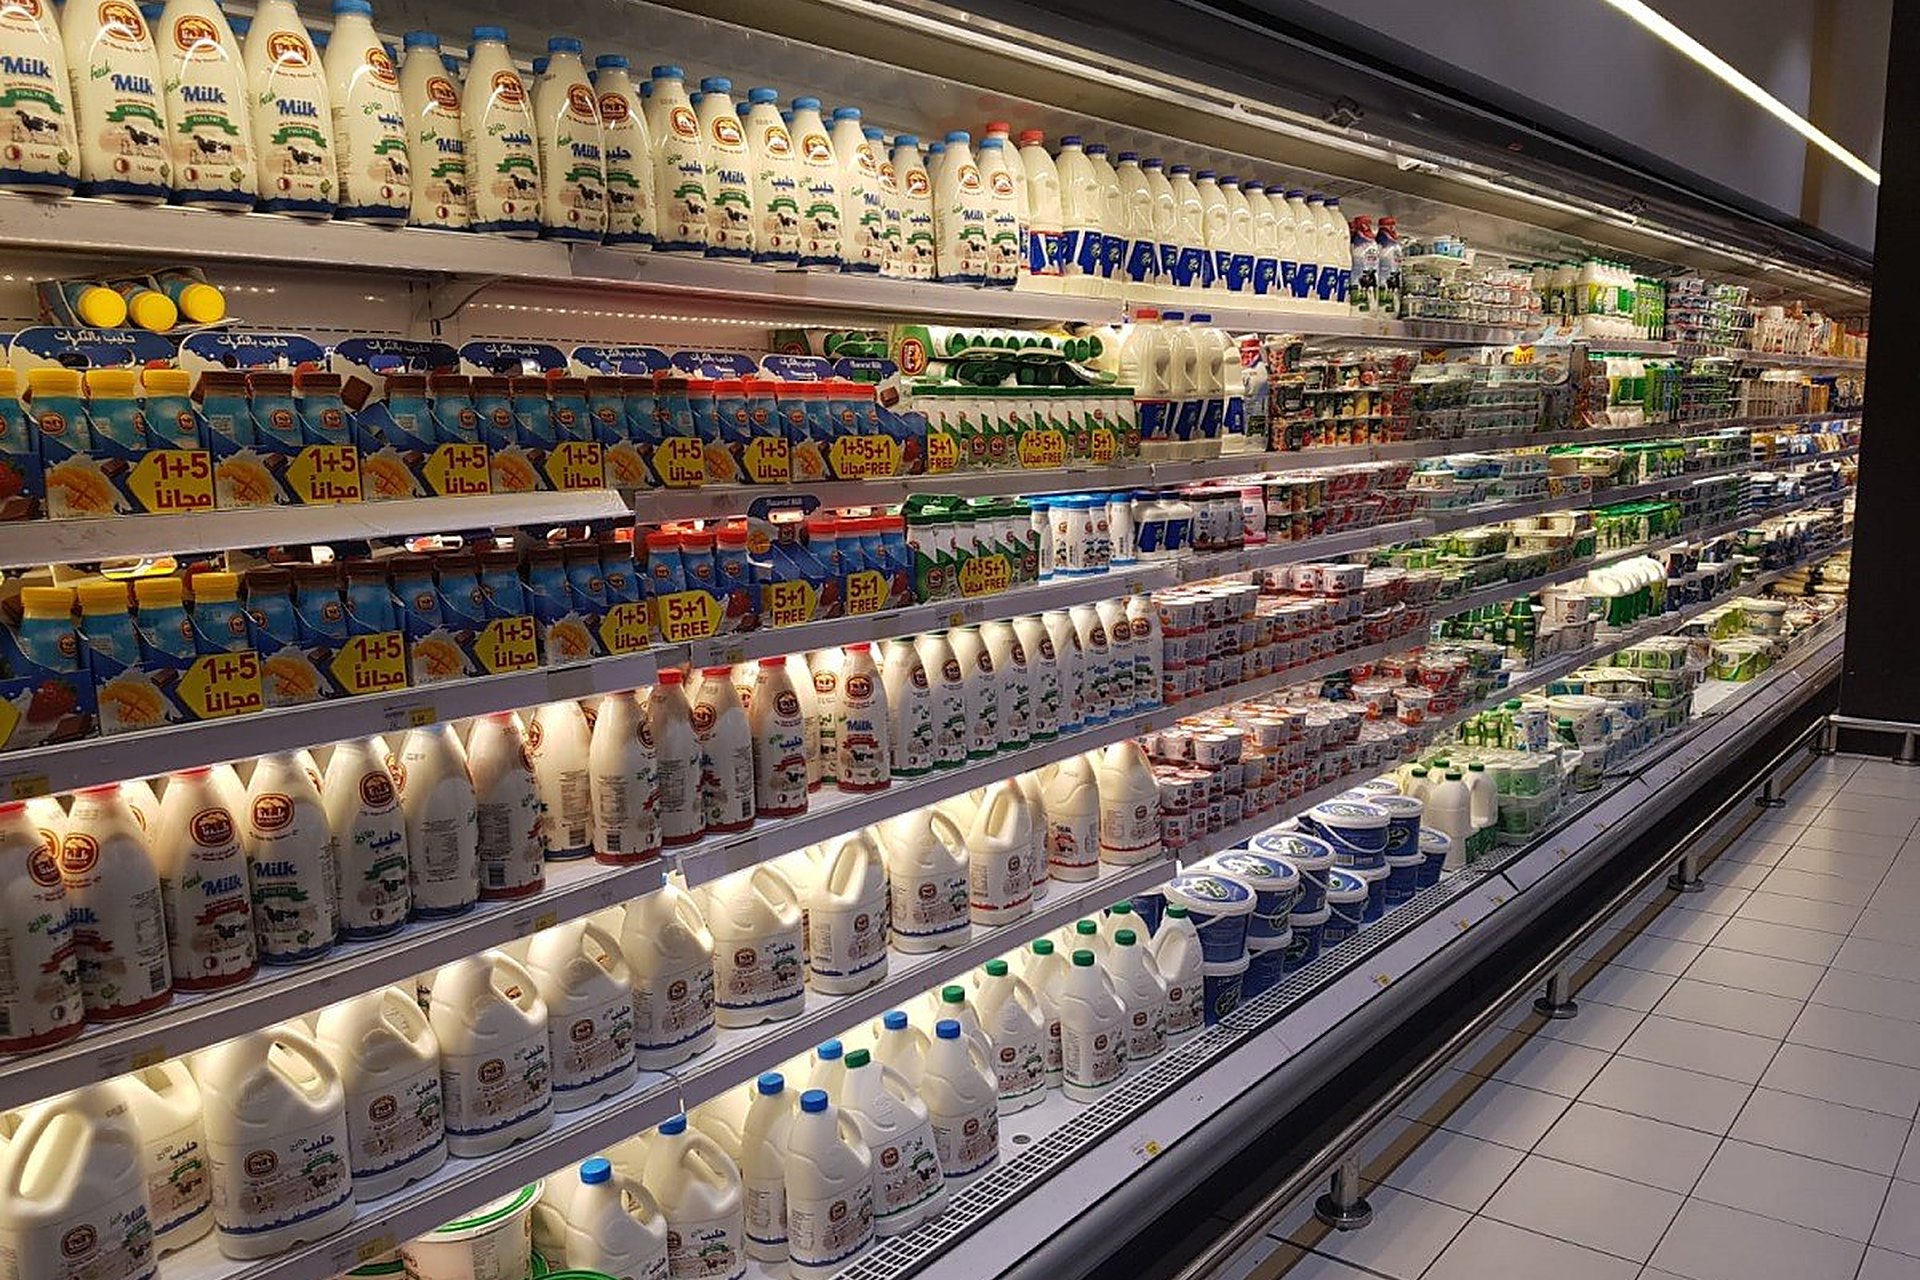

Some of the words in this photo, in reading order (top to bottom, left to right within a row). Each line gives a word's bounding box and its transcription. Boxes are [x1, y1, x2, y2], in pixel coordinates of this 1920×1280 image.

[1, 56, 51, 78] Milk
[111, 74, 155, 95] Milk
[180, 85, 226, 104] Milk
[276, 99, 318, 118] Milk
[501, 130, 532, 148] حليب
[678, 160, 702, 177] حليب
[718, 169, 747, 186] Milk
[771, 176, 795, 191] حليب
[808, 182, 834, 198] حليب
[54, 331, 101, 346] بالنكهات
[103, 333, 136, 344] حليب
[217, 336, 256, 349] بالنكهات
[258, 336, 288, 347] حليب
[668, 439, 701, 459] 1+5
[757, 439, 787, 459] 1+5
[930, 438, 952, 455] 5+1
[1094, 433, 1111, 449] 5+1
[309, 448, 356, 474] 1+5
[444, 446, 485, 469] 1+5
[562, 444, 599, 467] 1+5
[930, 458, 953, 468] FREE
[1093, 450, 1112, 461] FREE
[153, 452, 208, 479] 1+5
[850, 576, 877, 595] 5+1
[775, 587, 805, 606] 5+1
[850, 598, 877, 611] FREE
[615, 606, 646, 626] 1+5
[670, 598, 707, 620] 5+1
[774, 608, 806, 624] FREE
[492, 620, 531, 641] 1+5
[671, 620, 710, 637] FREE
[355, 636, 401, 662] 1+5
[202, 655, 257, 683] 1+5
[847, 720, 873, 731] Milk
[369, 830, 401, 852] حليب
[254, 861, 297, 877] Milk
[201, 875, 243, 896] Milk
[170, 1140, 198, 1161] حليب
[304, 1134, 334, 1155] حليب
